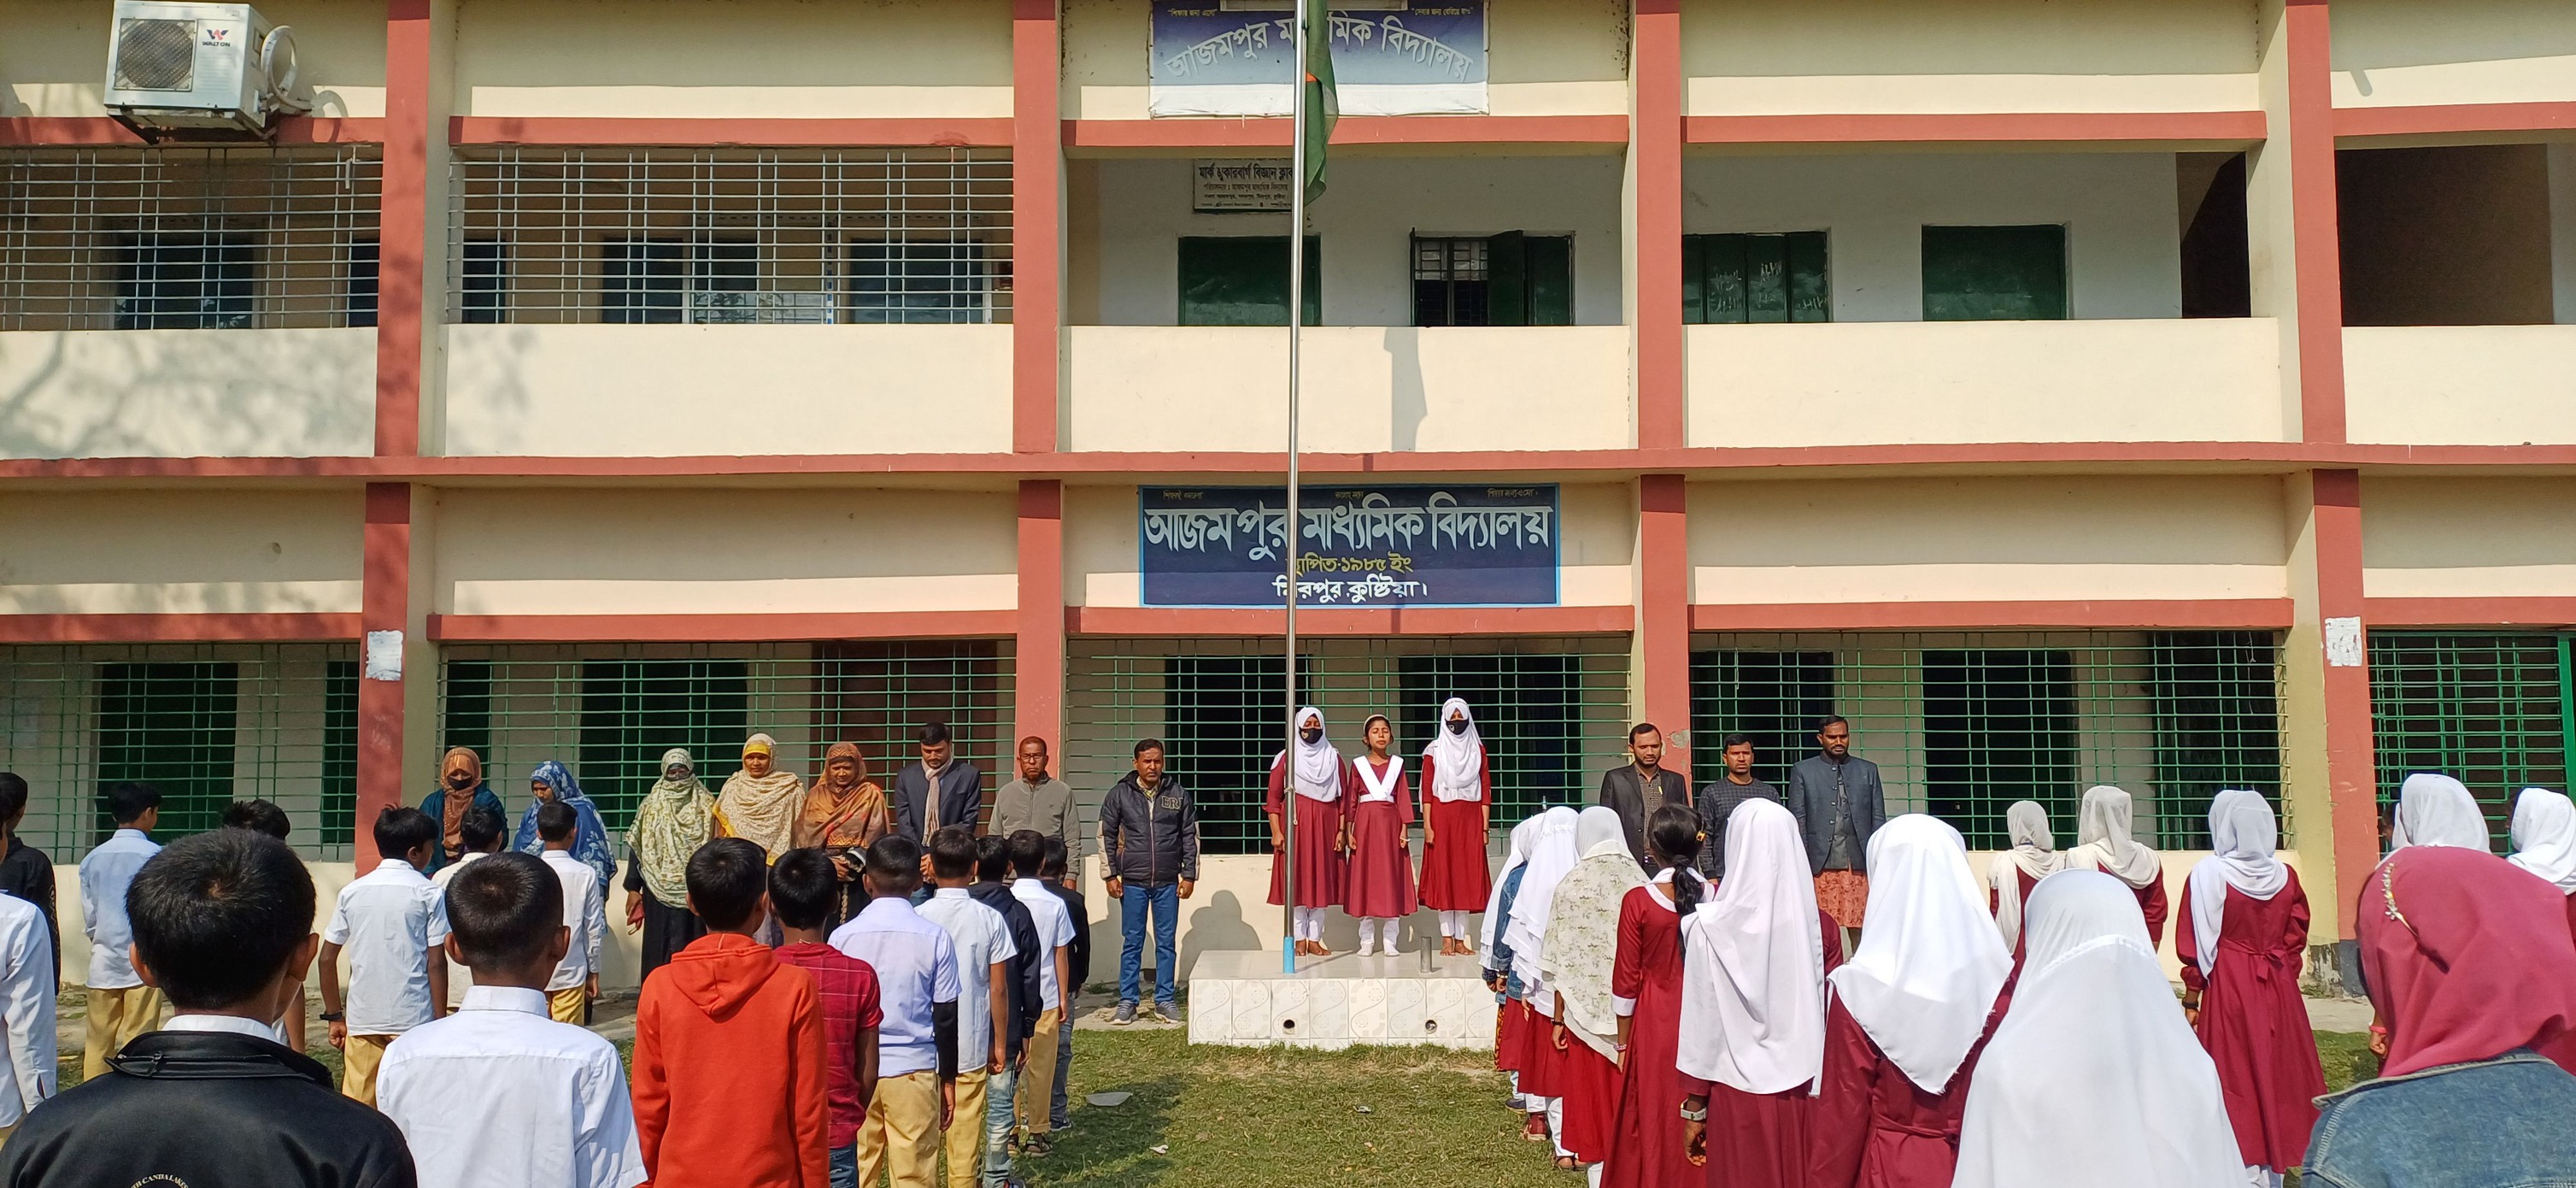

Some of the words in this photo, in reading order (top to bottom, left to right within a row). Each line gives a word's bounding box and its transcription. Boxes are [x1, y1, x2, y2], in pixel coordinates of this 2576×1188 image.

[1164, 22, 1270, 78] আজমপুর
[1380, 15, 1474, 84] বিদ্যালয়
[1298, 491, 1426, 552] মাধ্যমিক
[1426, 491, 1553, 551] বিদ্যালয়
[142, 1173, 169, 1185] CANDIA
